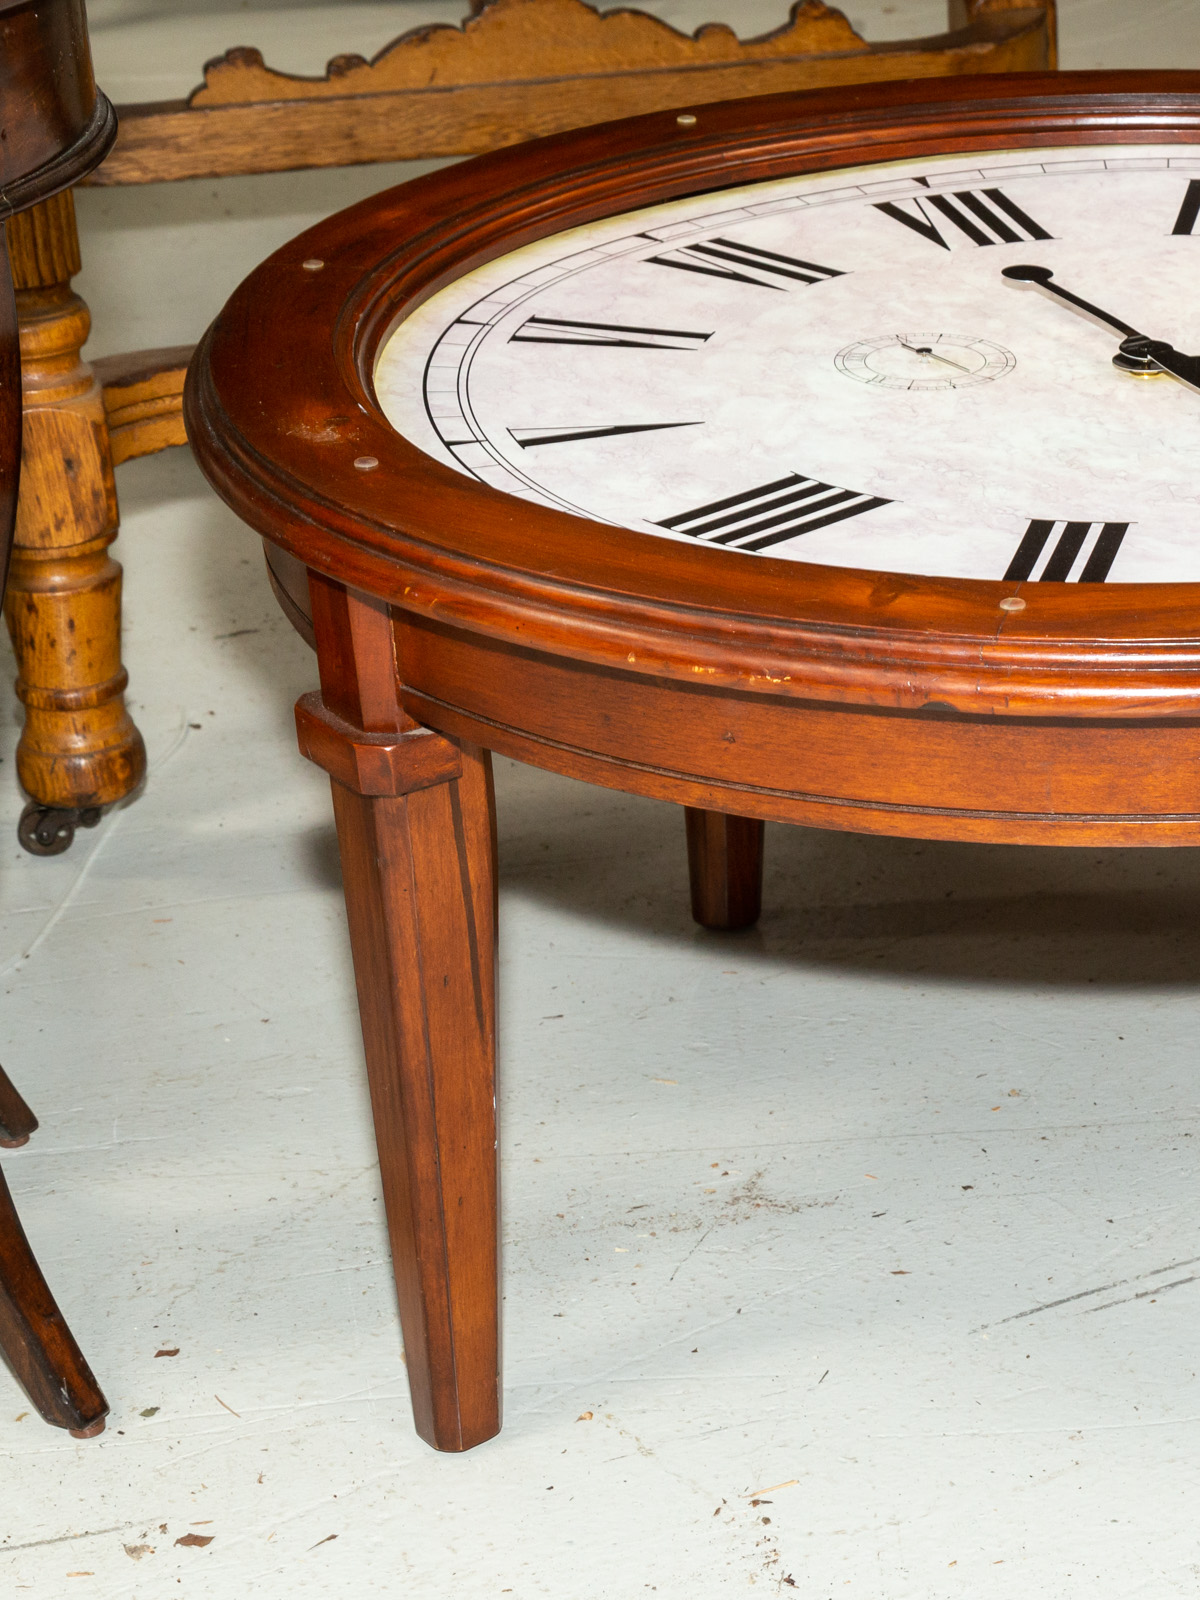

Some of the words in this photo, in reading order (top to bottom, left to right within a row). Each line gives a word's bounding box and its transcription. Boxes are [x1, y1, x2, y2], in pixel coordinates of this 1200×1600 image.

[872, 187, 1062, 251] VIII
[639, 236, 854, 292] VII
[507, 313, 716, 351] VI
[506, 421, 706, 449] V
[643, 471, 905, 553] IIII
[1002, 517, 1139, 583] III
